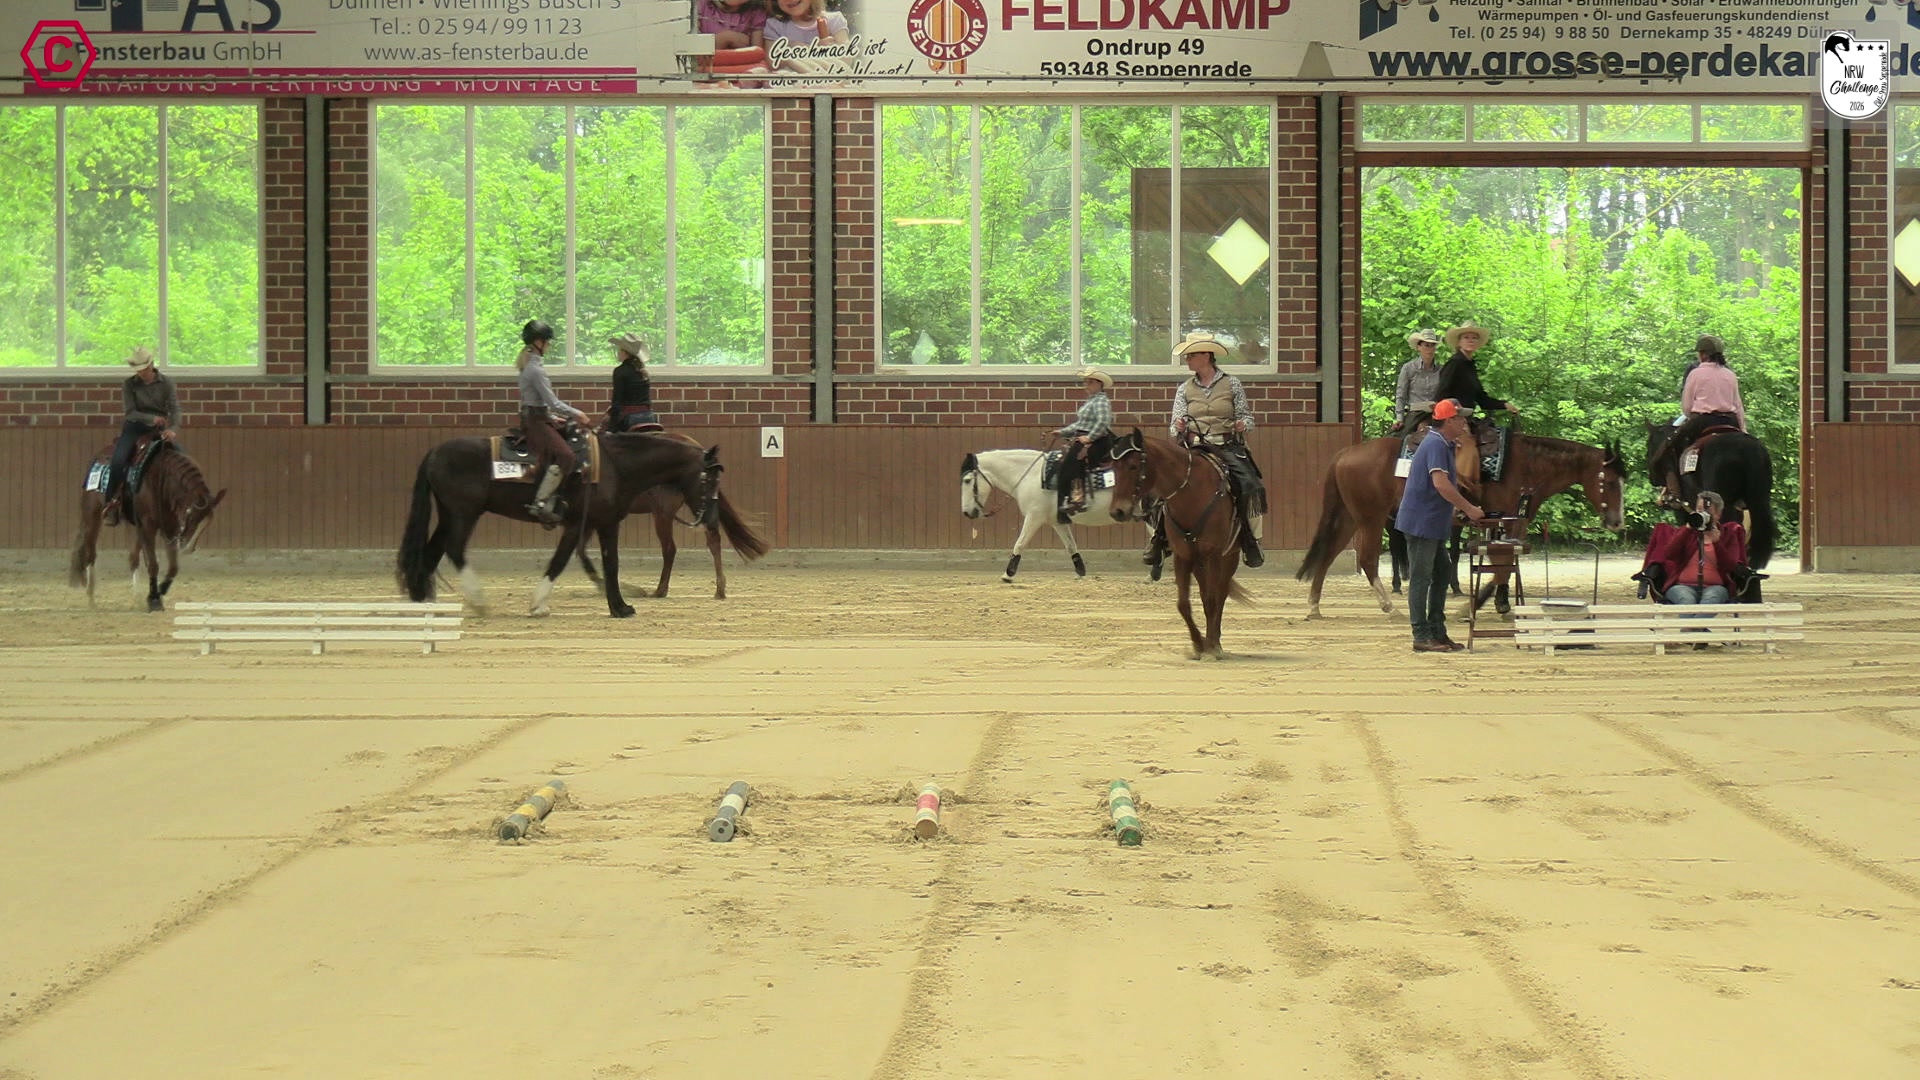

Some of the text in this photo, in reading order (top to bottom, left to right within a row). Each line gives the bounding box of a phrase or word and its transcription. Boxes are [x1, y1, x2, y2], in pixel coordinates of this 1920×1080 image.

[1002, 0, 1290, 30] FELDKAMP
[1478, 8, 1829, 23] Wärmepumpen Öl- und Gasfeuerungskundendienst
[370, 17, 411, 35] Tel.:
[1449, 26, 1475, 39] Tel.
[1500, 26, 1518, 39] 25
[1522, 26, 1545, 41] 94)
[1555, 26, 1564, 39] 9
[1569, 26, 1586, 39] 88
[1592, 26, 1609, 39] 50
[1621, 26, 1709, 41] Dernekamp
[1714, 26, 1732, 39] 35
[1747, 26, 1792, 39] 48249
[1797, 26, 1857, 39] Dülmn
[909, 18, 985, 59] FELDKAMP
[213, 41, 282, 61] GmbH
[364, 42, 588, 62] www.as-fensterbau.de
[770, 35, 888, 66] Geschmack ist
[1087, 38, 1205, 59] Ondrup 49
[1115, 60, 1253, 76] Seppenrade
[766, 434, 779, 449] A
[497, 463, 518, 474] 892
